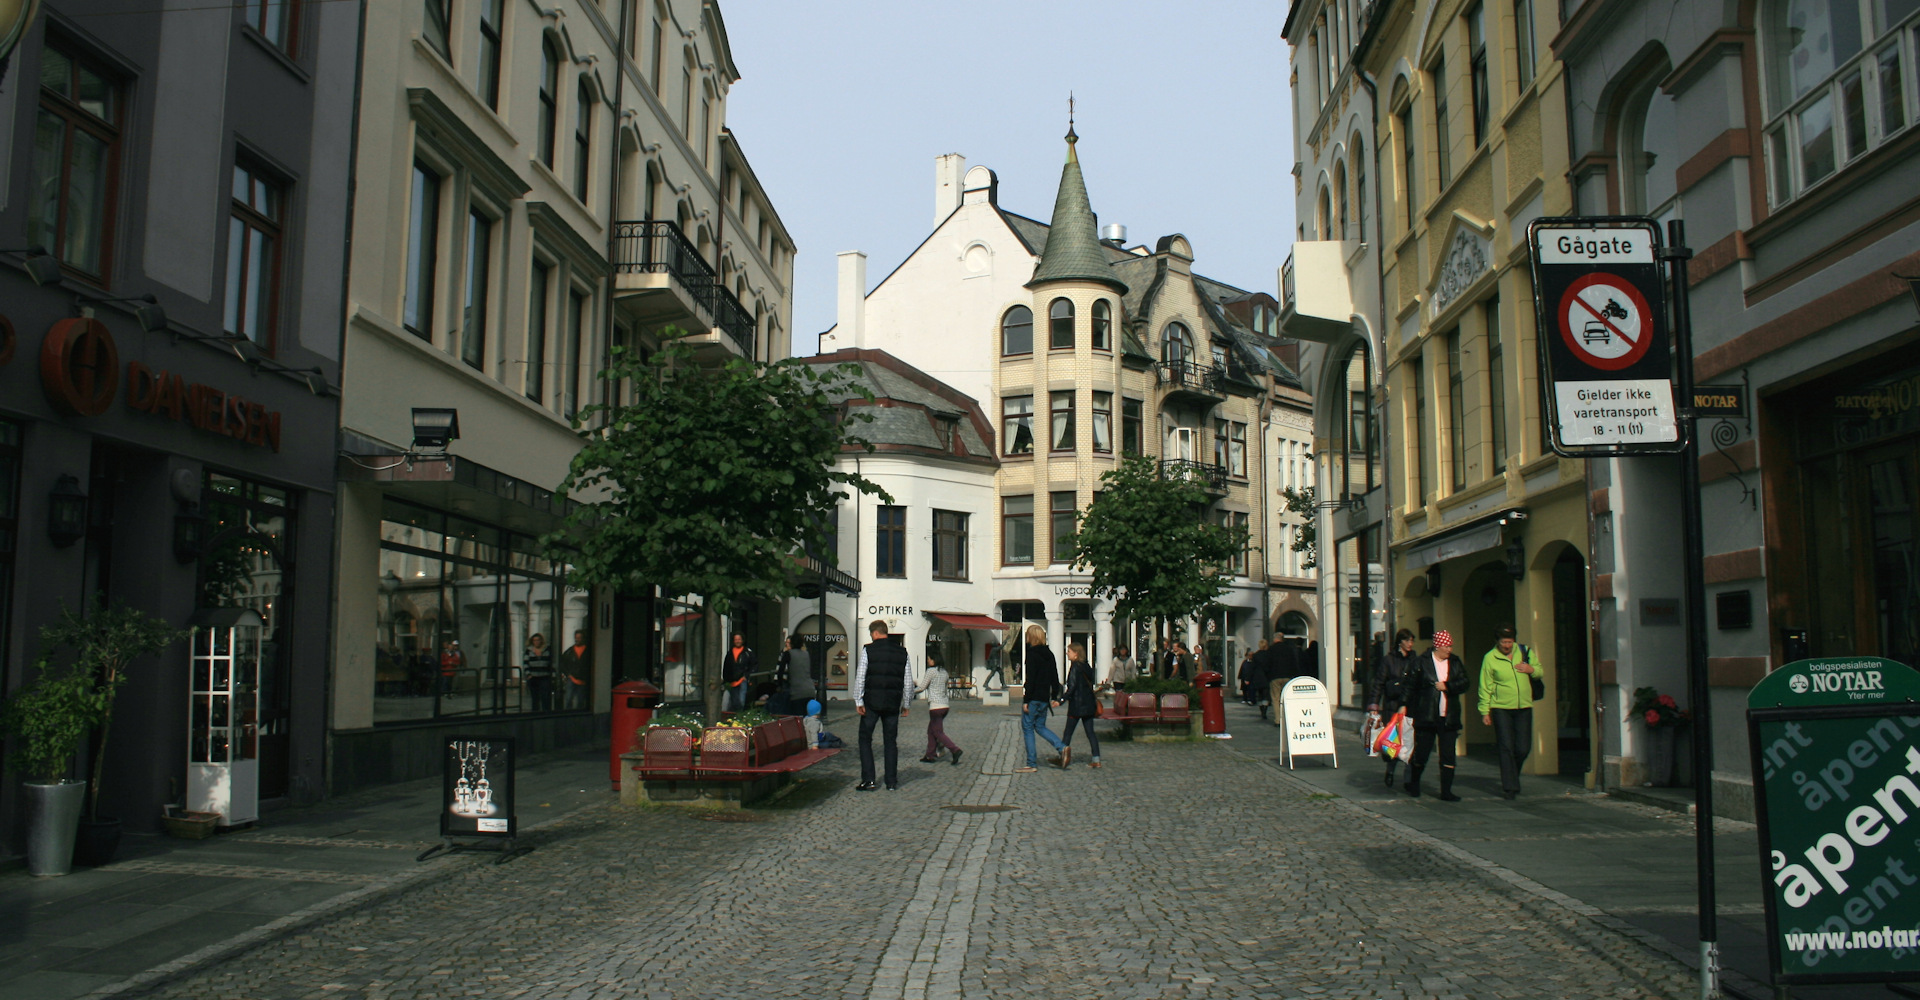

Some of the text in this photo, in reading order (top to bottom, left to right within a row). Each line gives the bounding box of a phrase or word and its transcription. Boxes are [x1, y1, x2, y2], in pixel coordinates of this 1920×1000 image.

[1557, 235, 1632, 258] Gågate
[1625, 389, 1651, 400] ikke
[128, 360, 281, 453] DANIELSEN
[1694, 395, 1738, 408] NOTAR
[1573, 405, 1658, 421] varetransport
[1593, 425, 1604, 436] 18
[1617, 425, 1625, 435] 11
[1628, 422, 1644, 436] (11)
[868, 605, 914, 616] OPTIKER
[1809, 661, 1882, 673] boligspesialisten
[1811, 671, 1884, 692] NOTAR
[1847, 692, 1866, 700] Yter
[1299, 720, 1316, 728] har
[1292, 731, 1326, 742] åpent!
